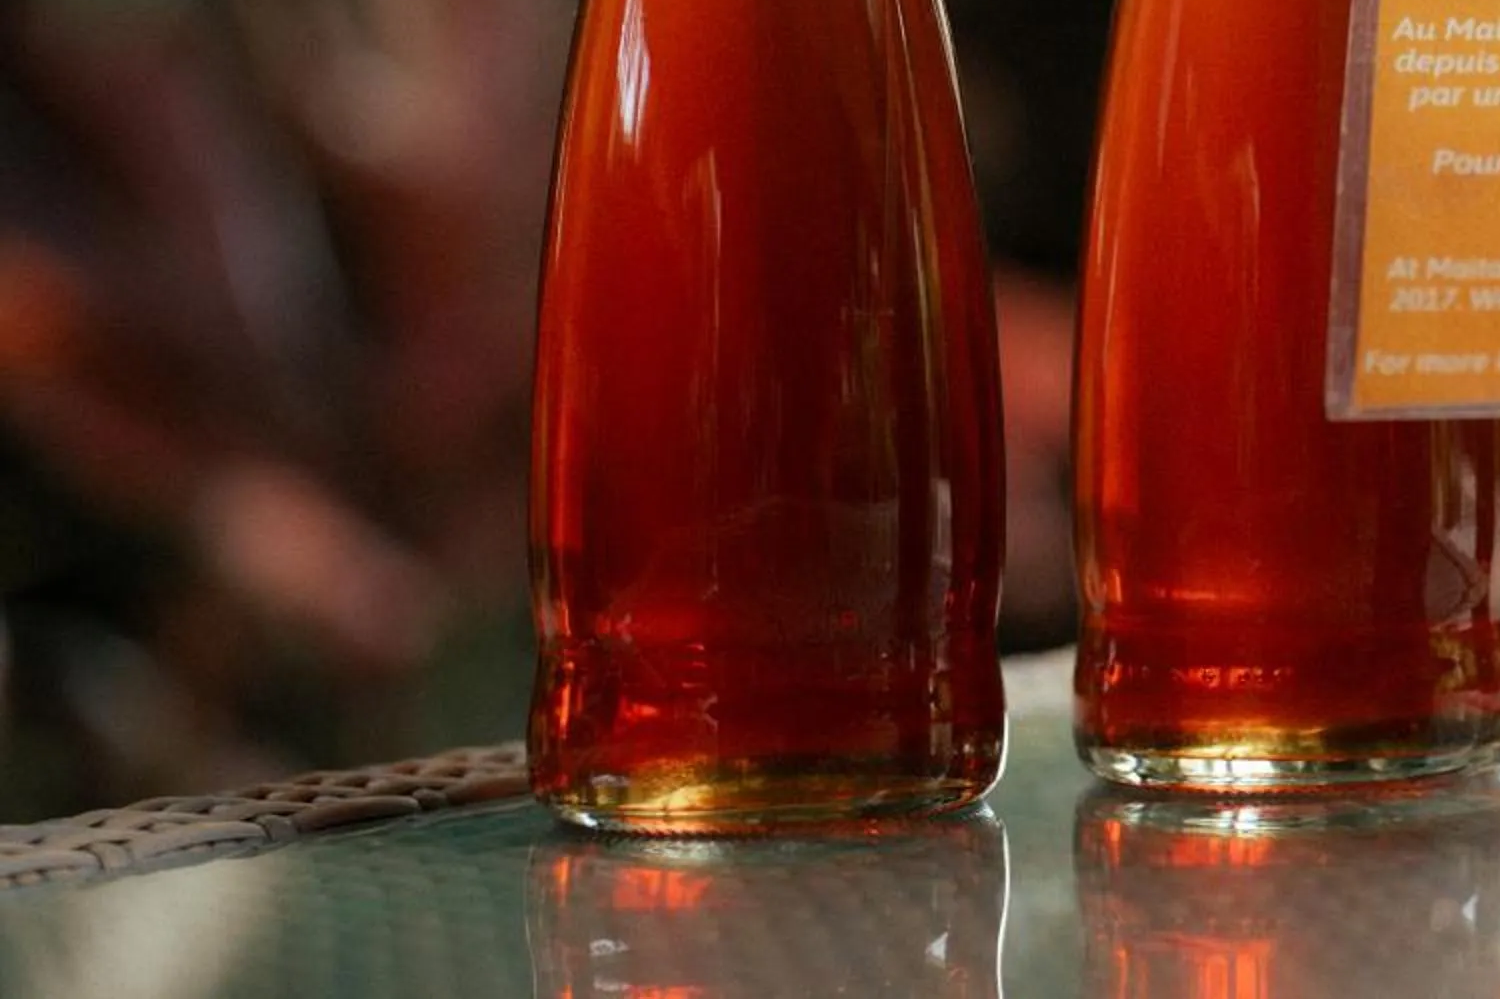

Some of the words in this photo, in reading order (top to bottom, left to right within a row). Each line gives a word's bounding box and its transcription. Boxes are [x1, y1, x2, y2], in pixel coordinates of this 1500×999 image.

[1393, 17, 1437, 41] Au
[1393, 49, 1500, 78] depuis
[1408, 84, 1465, 112] par
